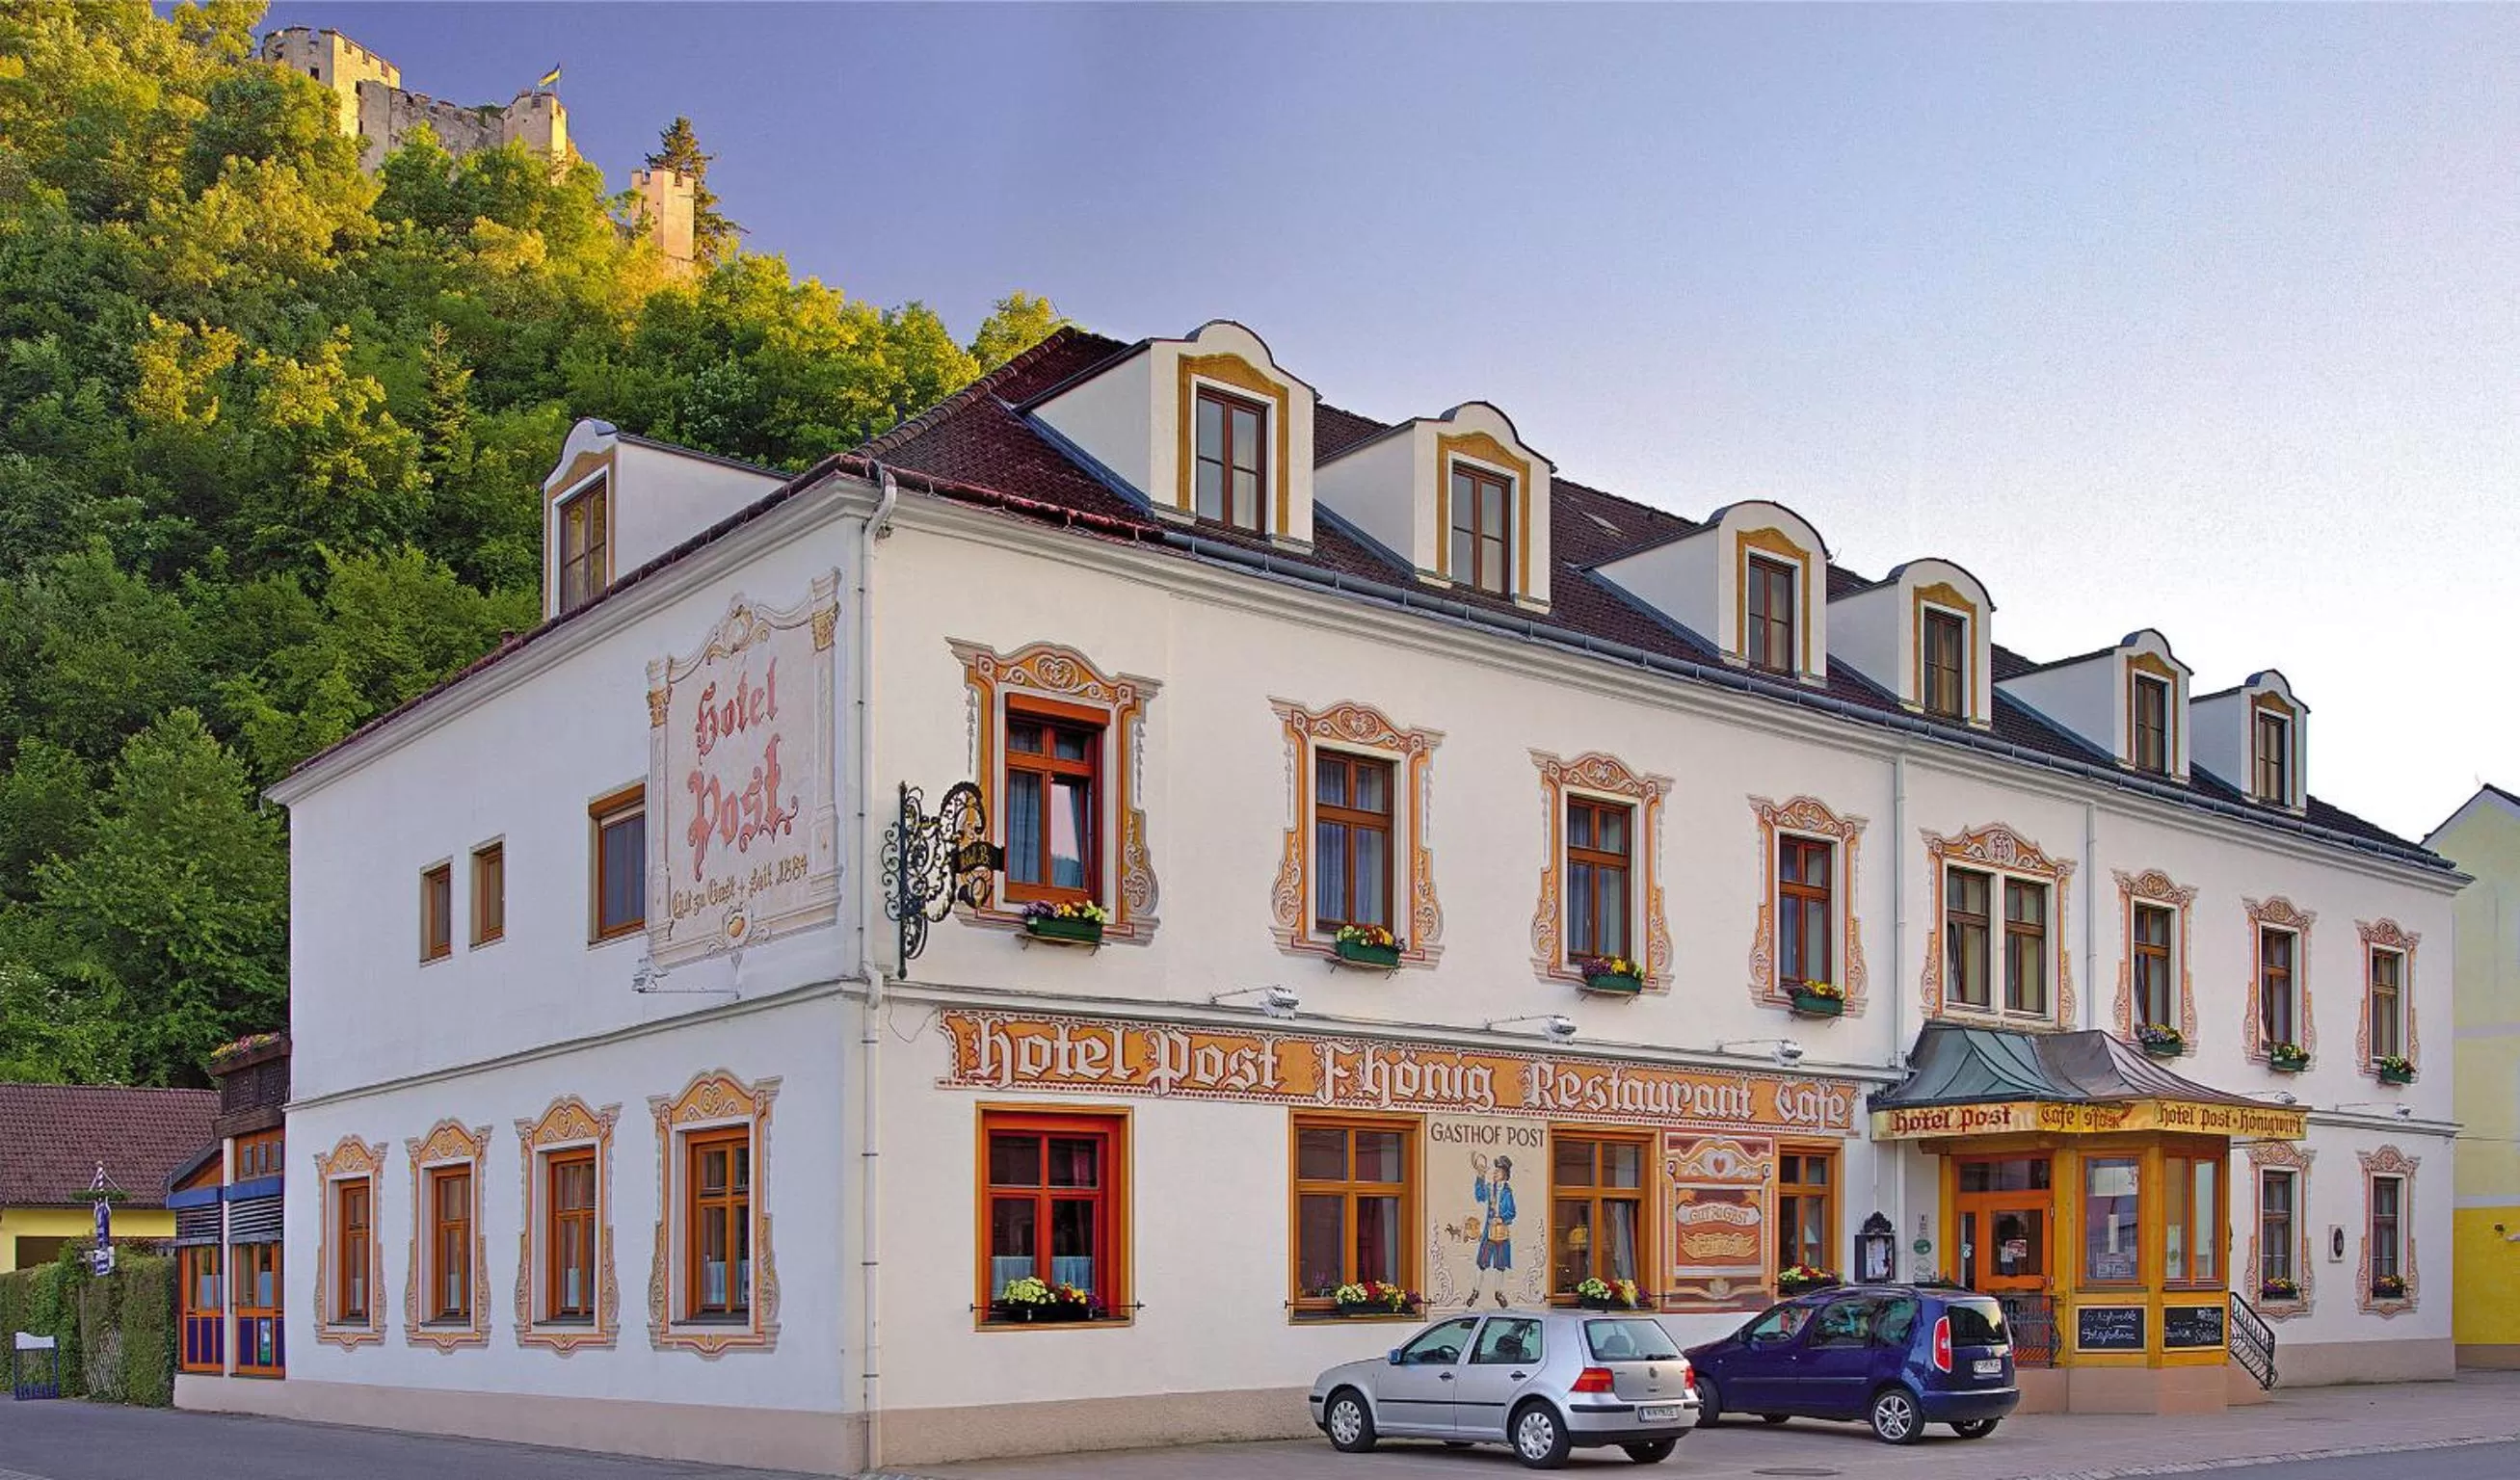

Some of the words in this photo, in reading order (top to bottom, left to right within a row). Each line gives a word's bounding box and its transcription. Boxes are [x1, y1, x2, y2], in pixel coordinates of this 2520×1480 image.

[695, 656, 778, 765] Hotel
[687, 733, 799, 882] Post
[1145, 1027, 1287, 1096] Post
[1521, 1060, 1755, 1120] Restaurant
[1430, 1122, 1501, 1145] GASTHOF
[1506, 1126, 1546, 1148] POST
